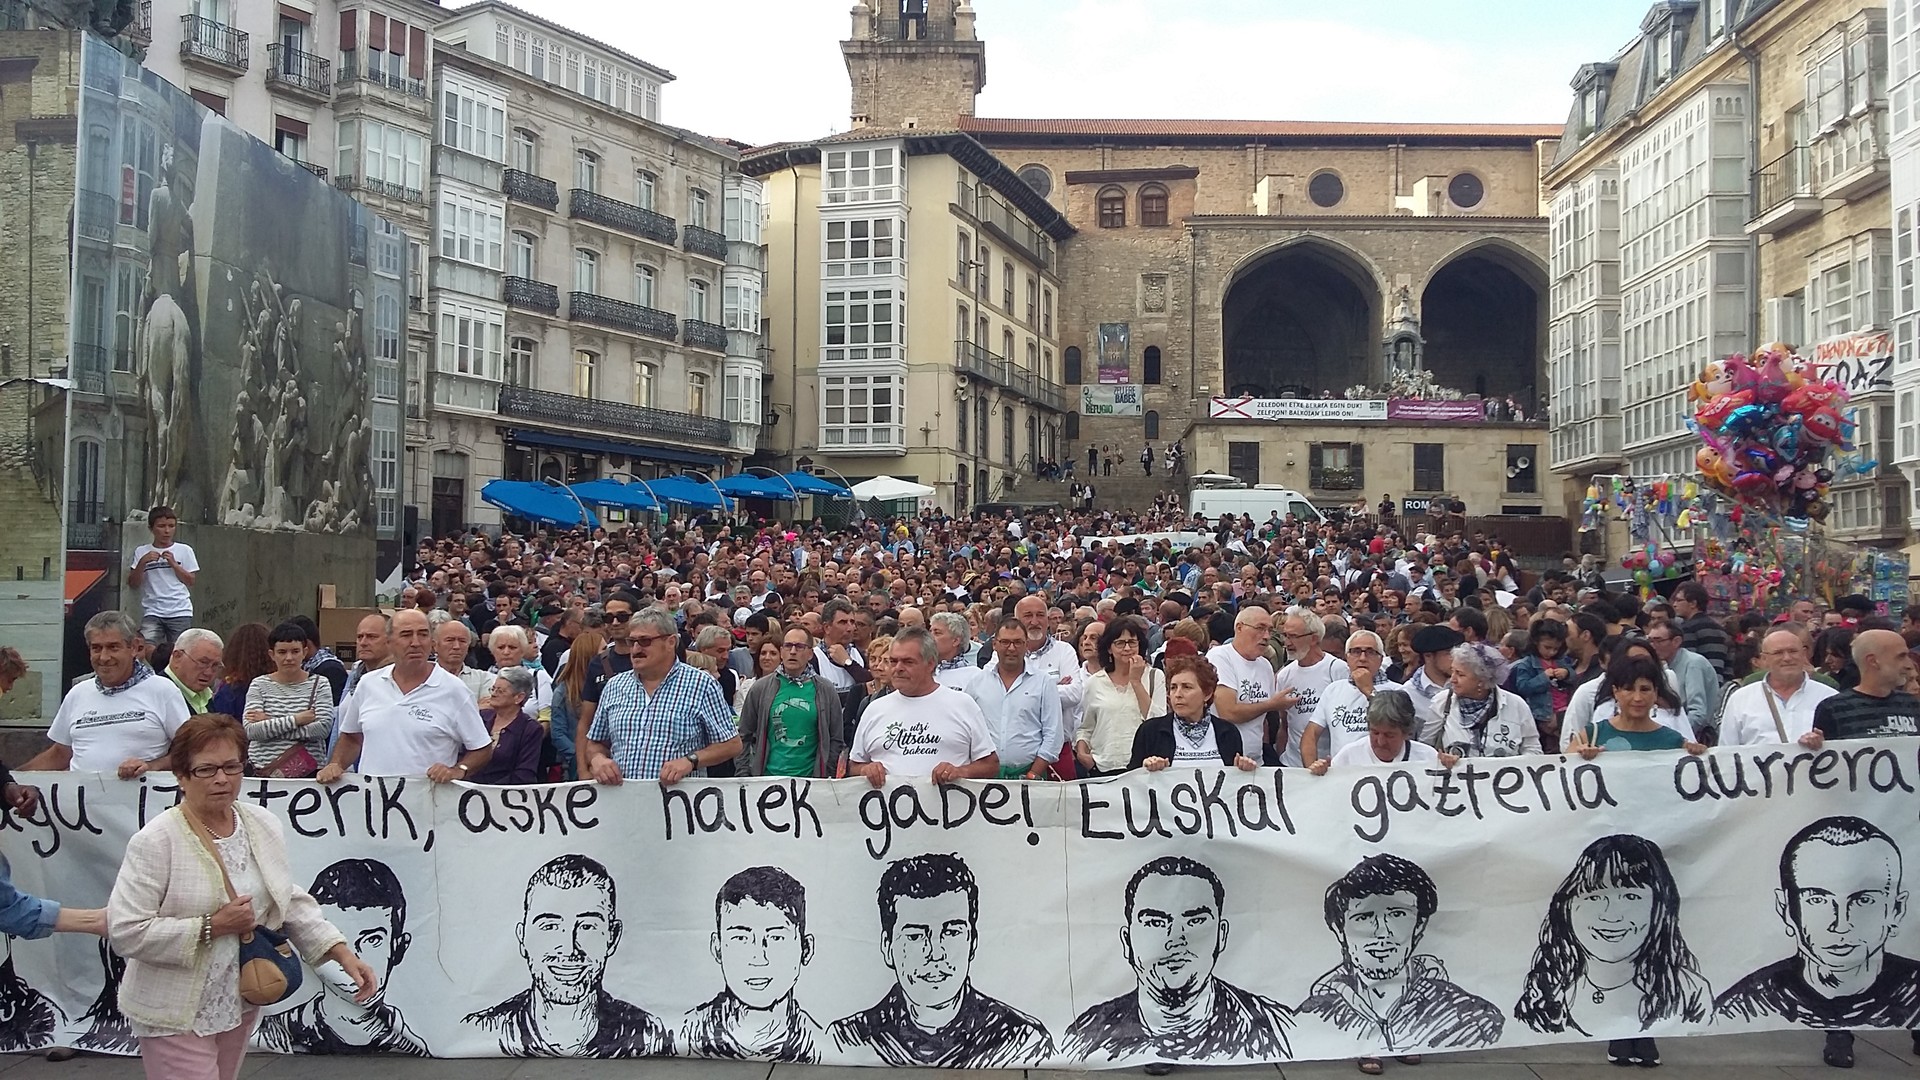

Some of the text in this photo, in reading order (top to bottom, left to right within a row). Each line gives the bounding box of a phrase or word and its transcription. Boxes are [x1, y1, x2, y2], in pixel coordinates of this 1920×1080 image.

[1332, 710, 1367, 727] Altsas
[910, 722, 930, 735] utzi
[883, 727, 942, 750] Altsasu
[903, 746, 939, 755] bakean
[1351, 756, 1618, 843] gazteria
[1674, 747, 1920, 821] aurrera
